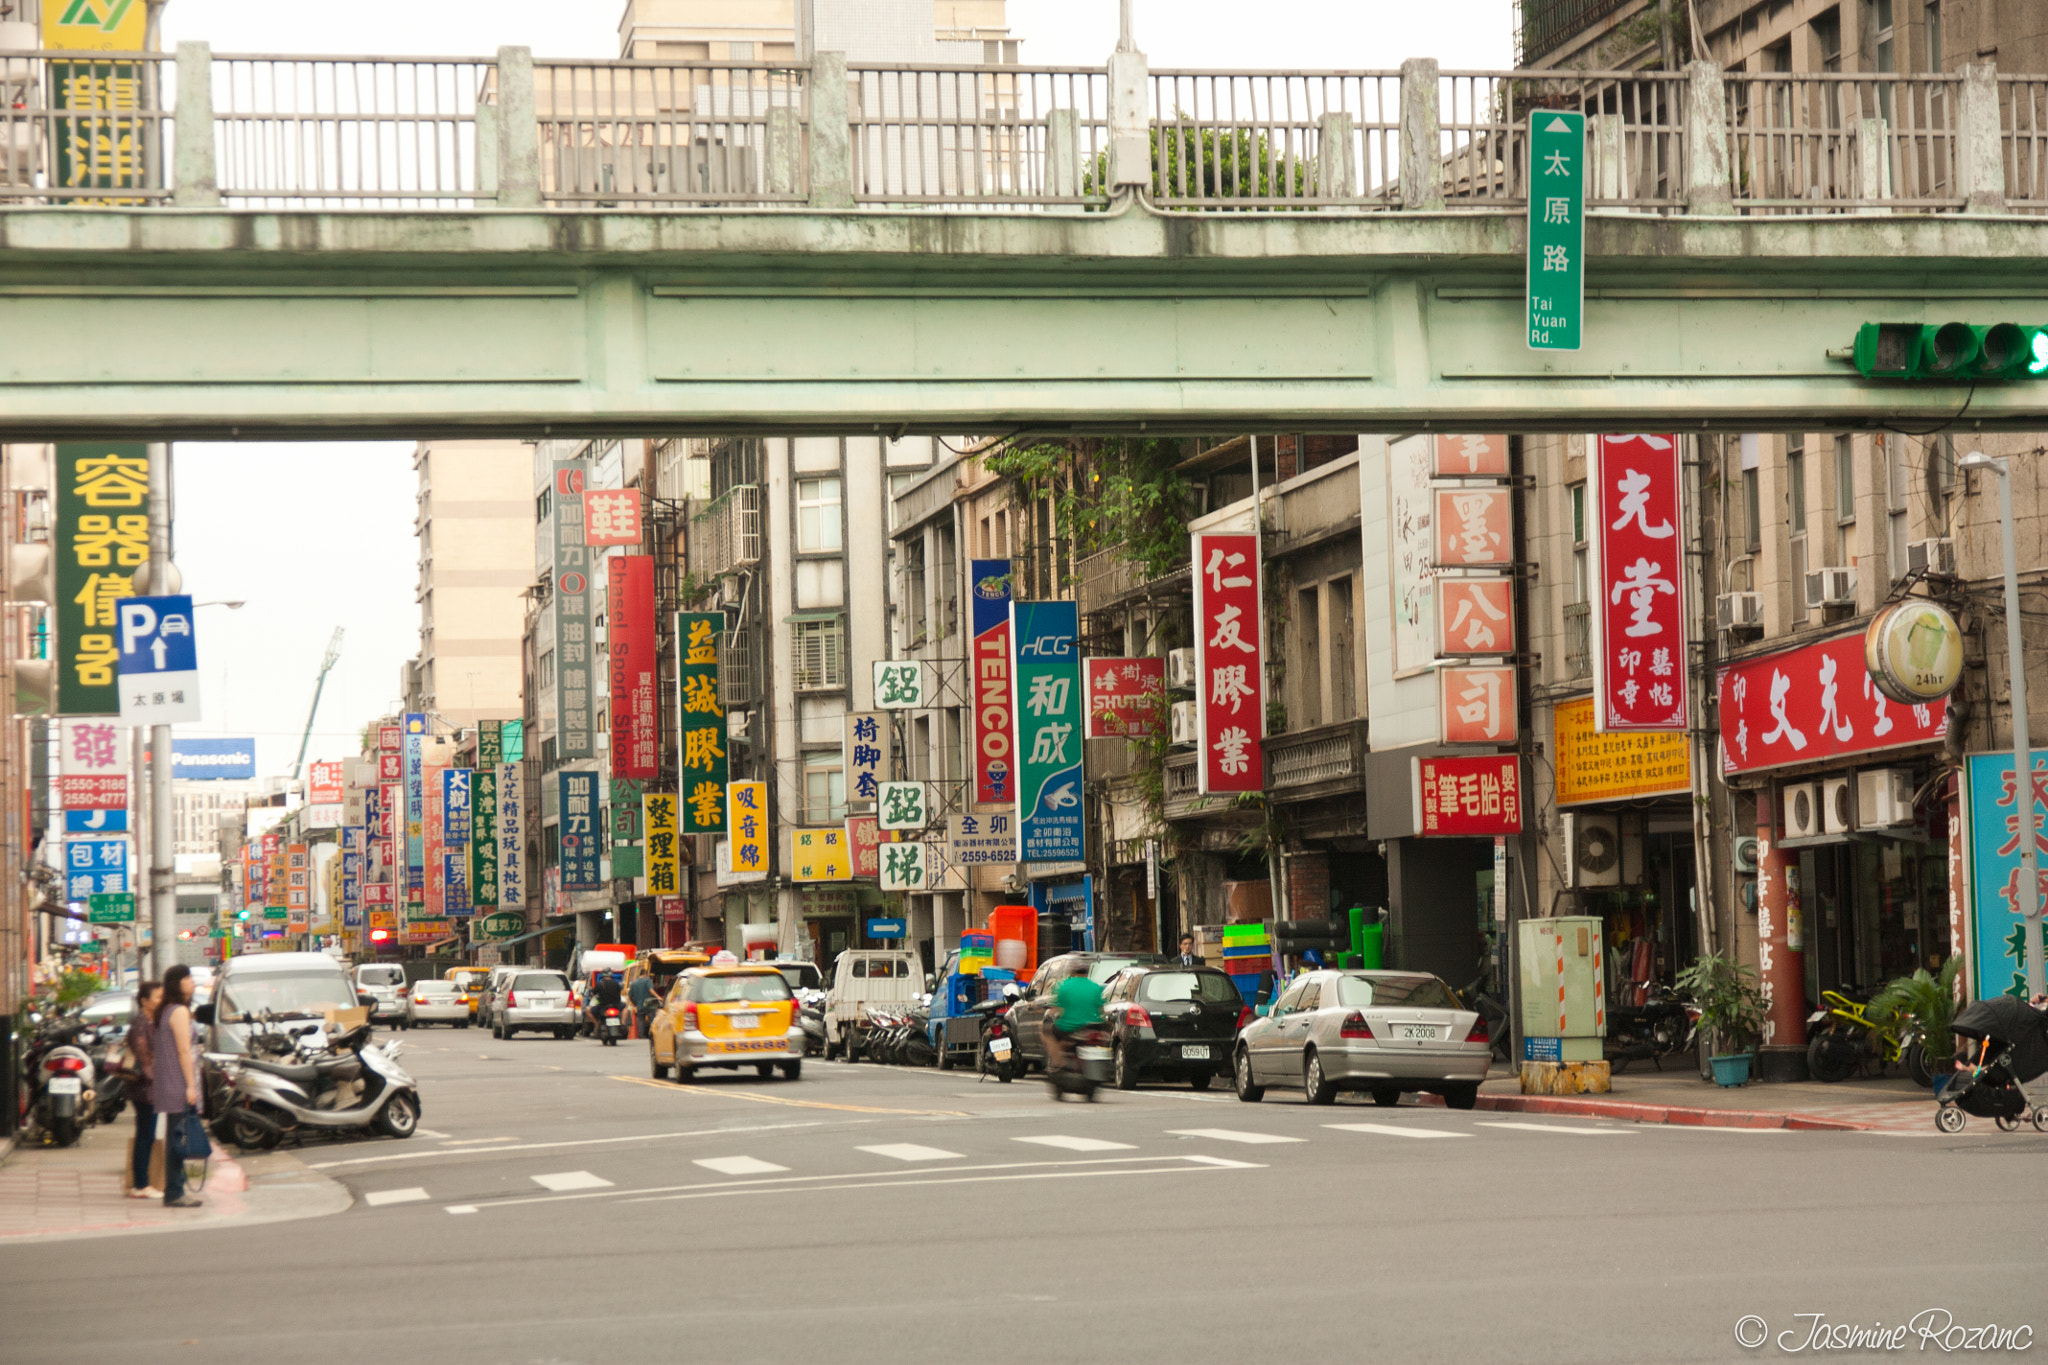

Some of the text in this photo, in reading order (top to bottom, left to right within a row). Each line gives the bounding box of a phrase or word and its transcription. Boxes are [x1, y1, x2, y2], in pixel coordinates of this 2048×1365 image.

[1543, 149, 1570, 272] 太原路
[1532, 297, 1552, 311] Tai
[1533, 314, 1566, 328] Yuan
[1532, 330, 1553, 344] Rd.
[589, 494, 638, 540] 鞋
[121, 604, 157, 654] P
[1020, 636, 1073, 656] HCG
[610, 556, 631, 779] Chasel Sport Shoes
[1205, 548, 1256, 776] 仁友膠業
[1617, 648, 1642, 710] 印章
[1915, 673, 1945, 687] 24hr
[980, 634, 1009, 759] TENCO
[1027, 674, 1073, 765] 和成
[1733, 673, 1748, 762] 印章
[72, 723, 117, 768] 發
[683, 619, 725, 827] 益誠膠業
[172, 752, 251, 766] Panasonic
[64, 779, 126, 791] 2550-3186
[64, 793, 126, 805] 2550-4777
[568, 777, 591, 833] 加耐力
[1502, 765, 1517, 823] 嬰兒
[70, 843, 124, 867] 包材
[647, 797, 675, 892] 整理箱
[962, 850, 1016, 863] 2559-6525
[1027, 848, 1080, 859] TEL:25596525
